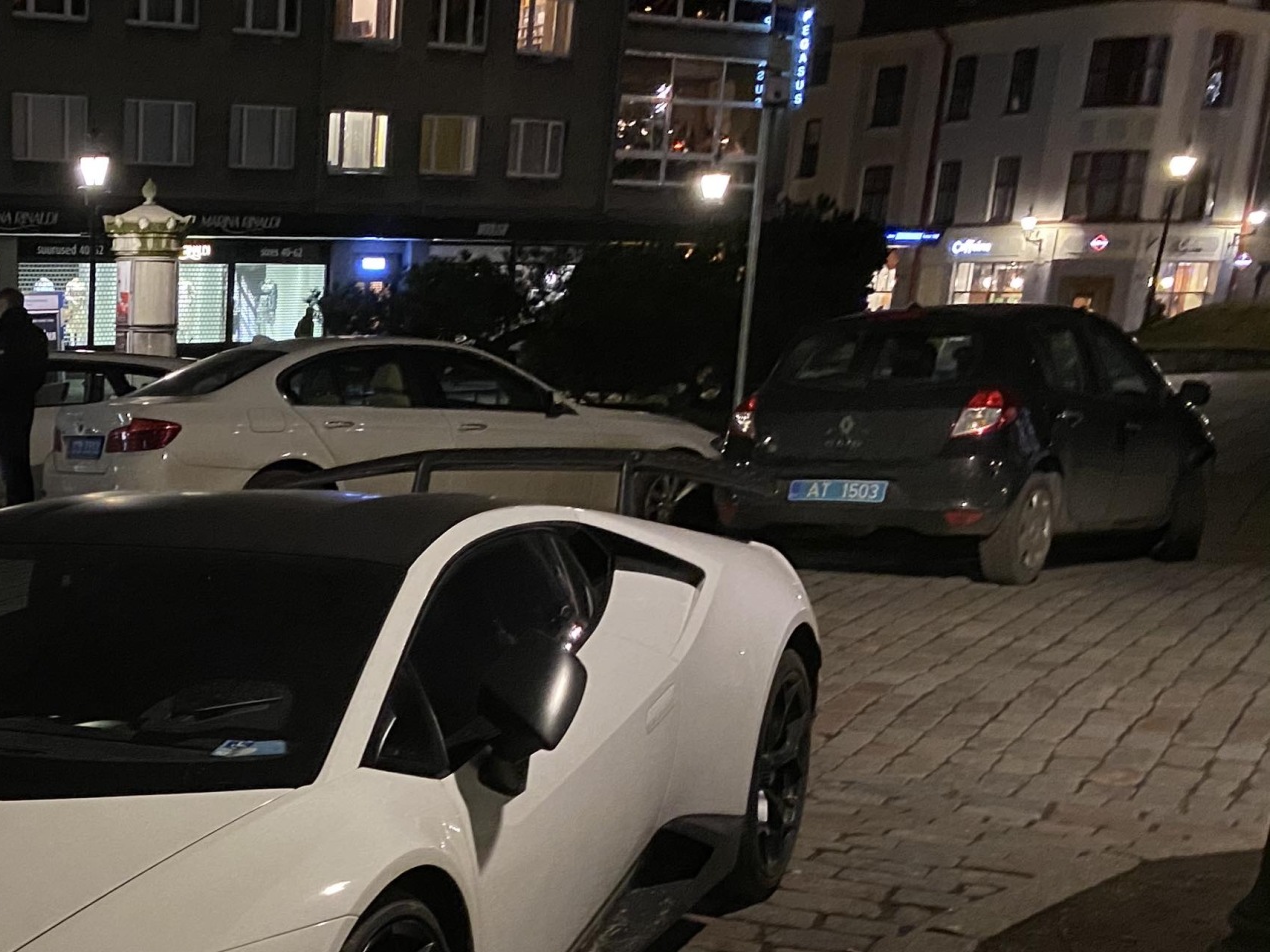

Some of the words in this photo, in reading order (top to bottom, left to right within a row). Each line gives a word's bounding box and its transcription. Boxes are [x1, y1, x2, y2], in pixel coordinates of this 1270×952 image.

[793, 6, 815, 105] PEGASUS
[806, 482, 831, 498] AT
[842, 483, 880, 499] 1503
